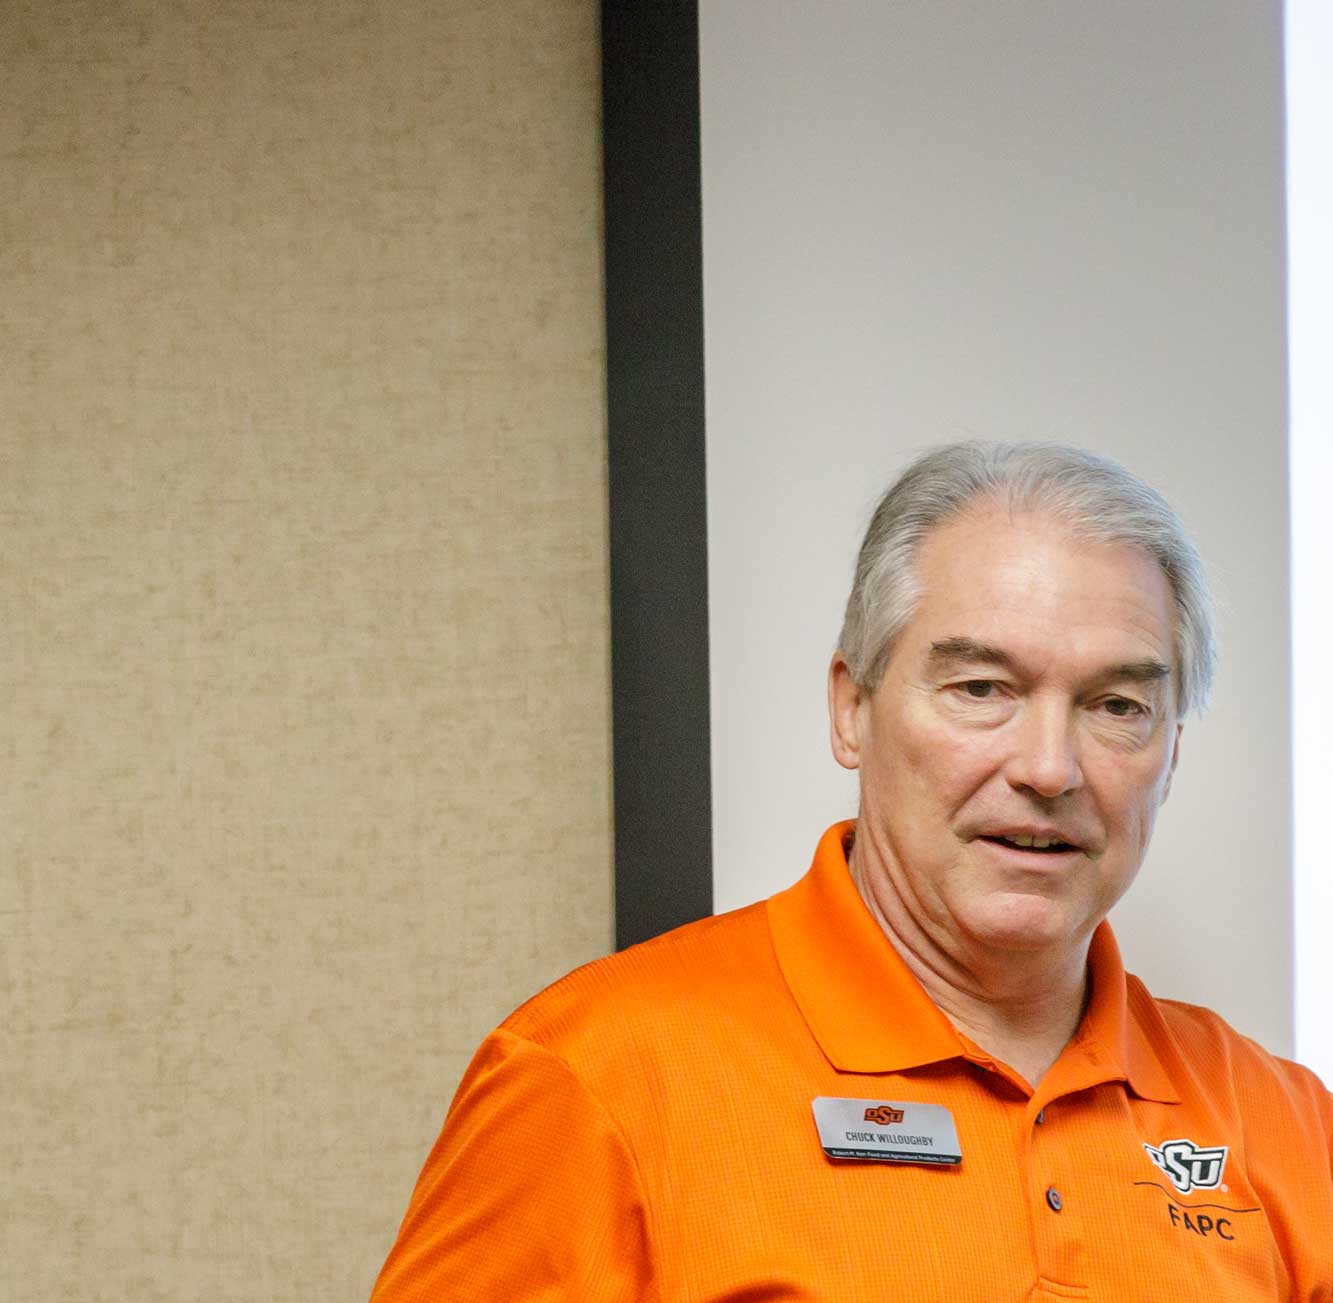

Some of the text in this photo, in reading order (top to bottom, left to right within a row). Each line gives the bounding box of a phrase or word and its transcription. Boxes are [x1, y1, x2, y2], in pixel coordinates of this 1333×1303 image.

[864, 1105, 904, 1125] OSU
[845, 1131, 934, 1147] CHUCK WILLOUGHBY
[1168, 1203, 1235, 1241] FAPC
